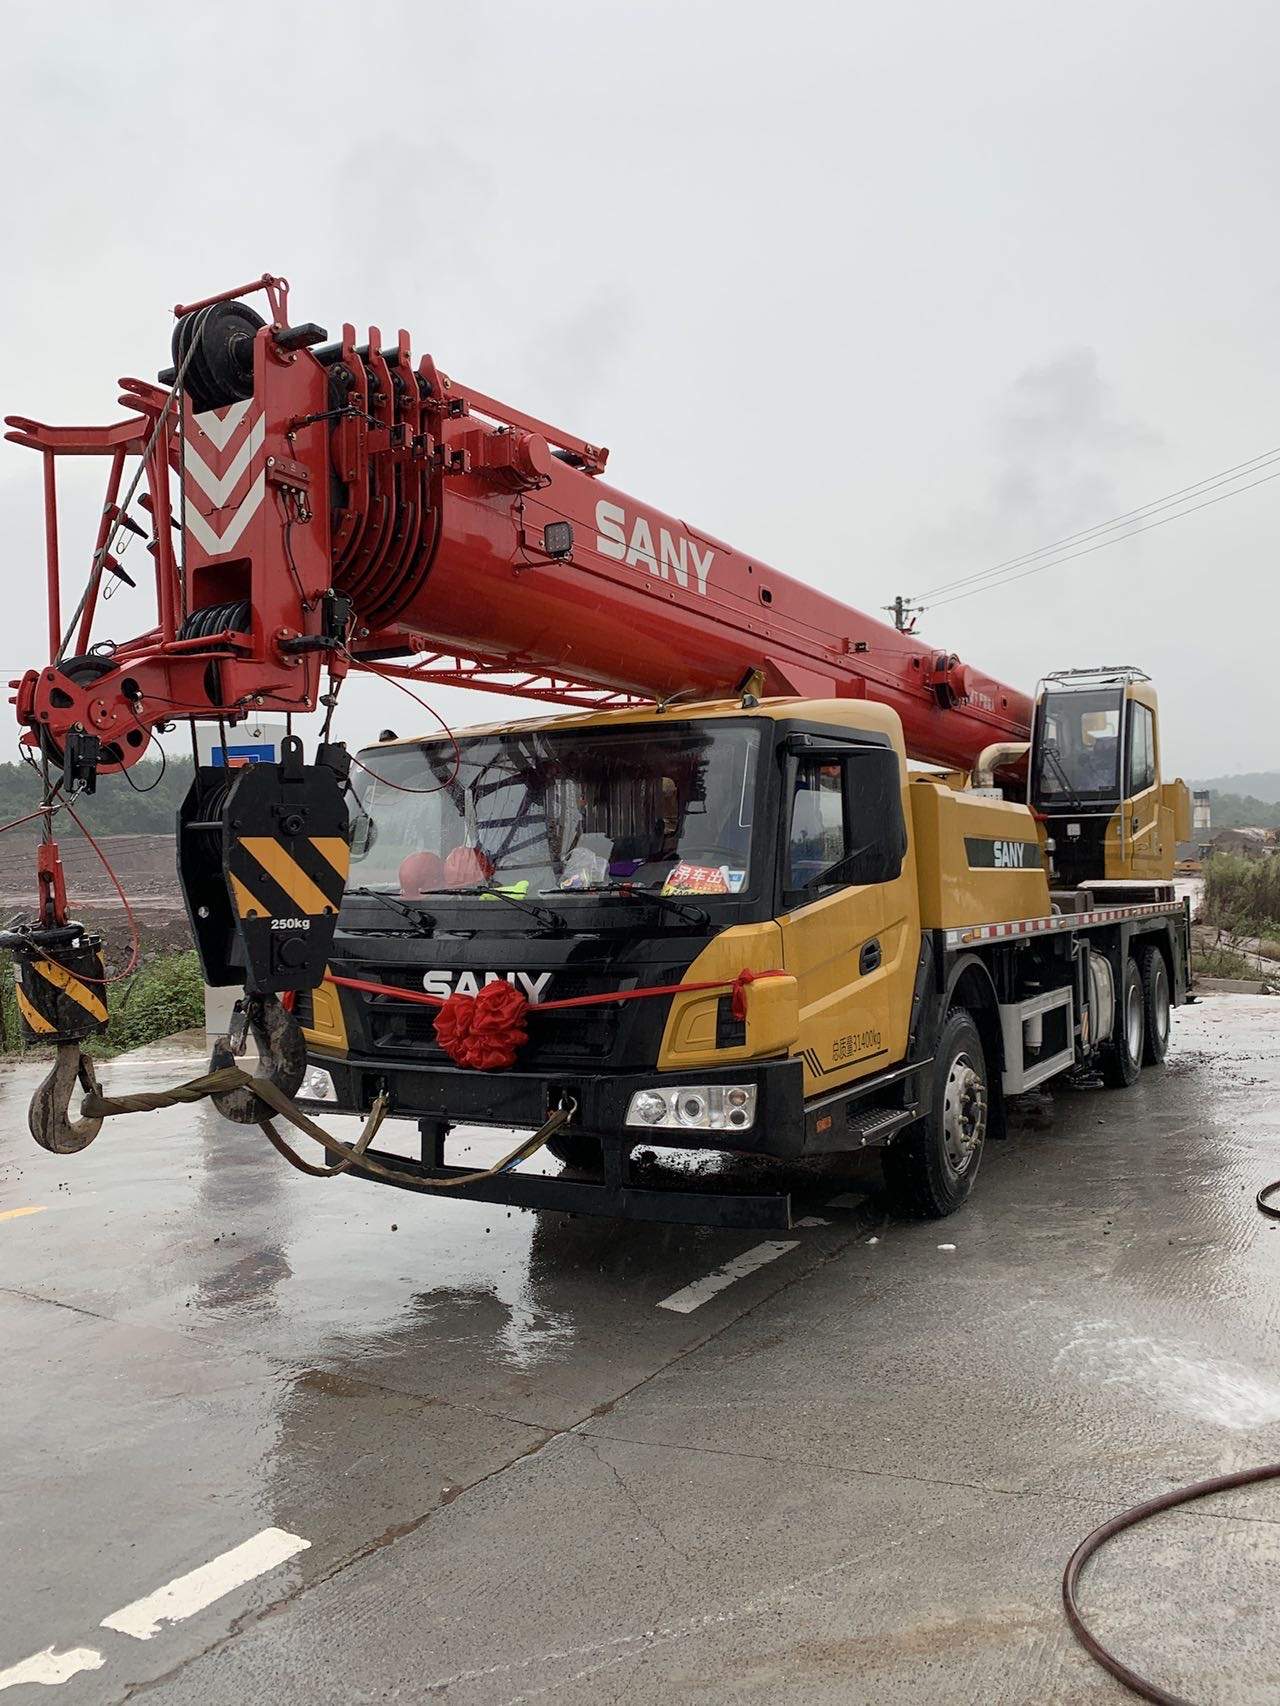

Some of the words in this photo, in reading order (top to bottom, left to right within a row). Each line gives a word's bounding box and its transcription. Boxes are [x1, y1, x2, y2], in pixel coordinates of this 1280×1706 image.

[595, 499, 715, 596] SANY
[993, 841, 1025, 868] SANY
[270, 918, 310, 930] 250kg
